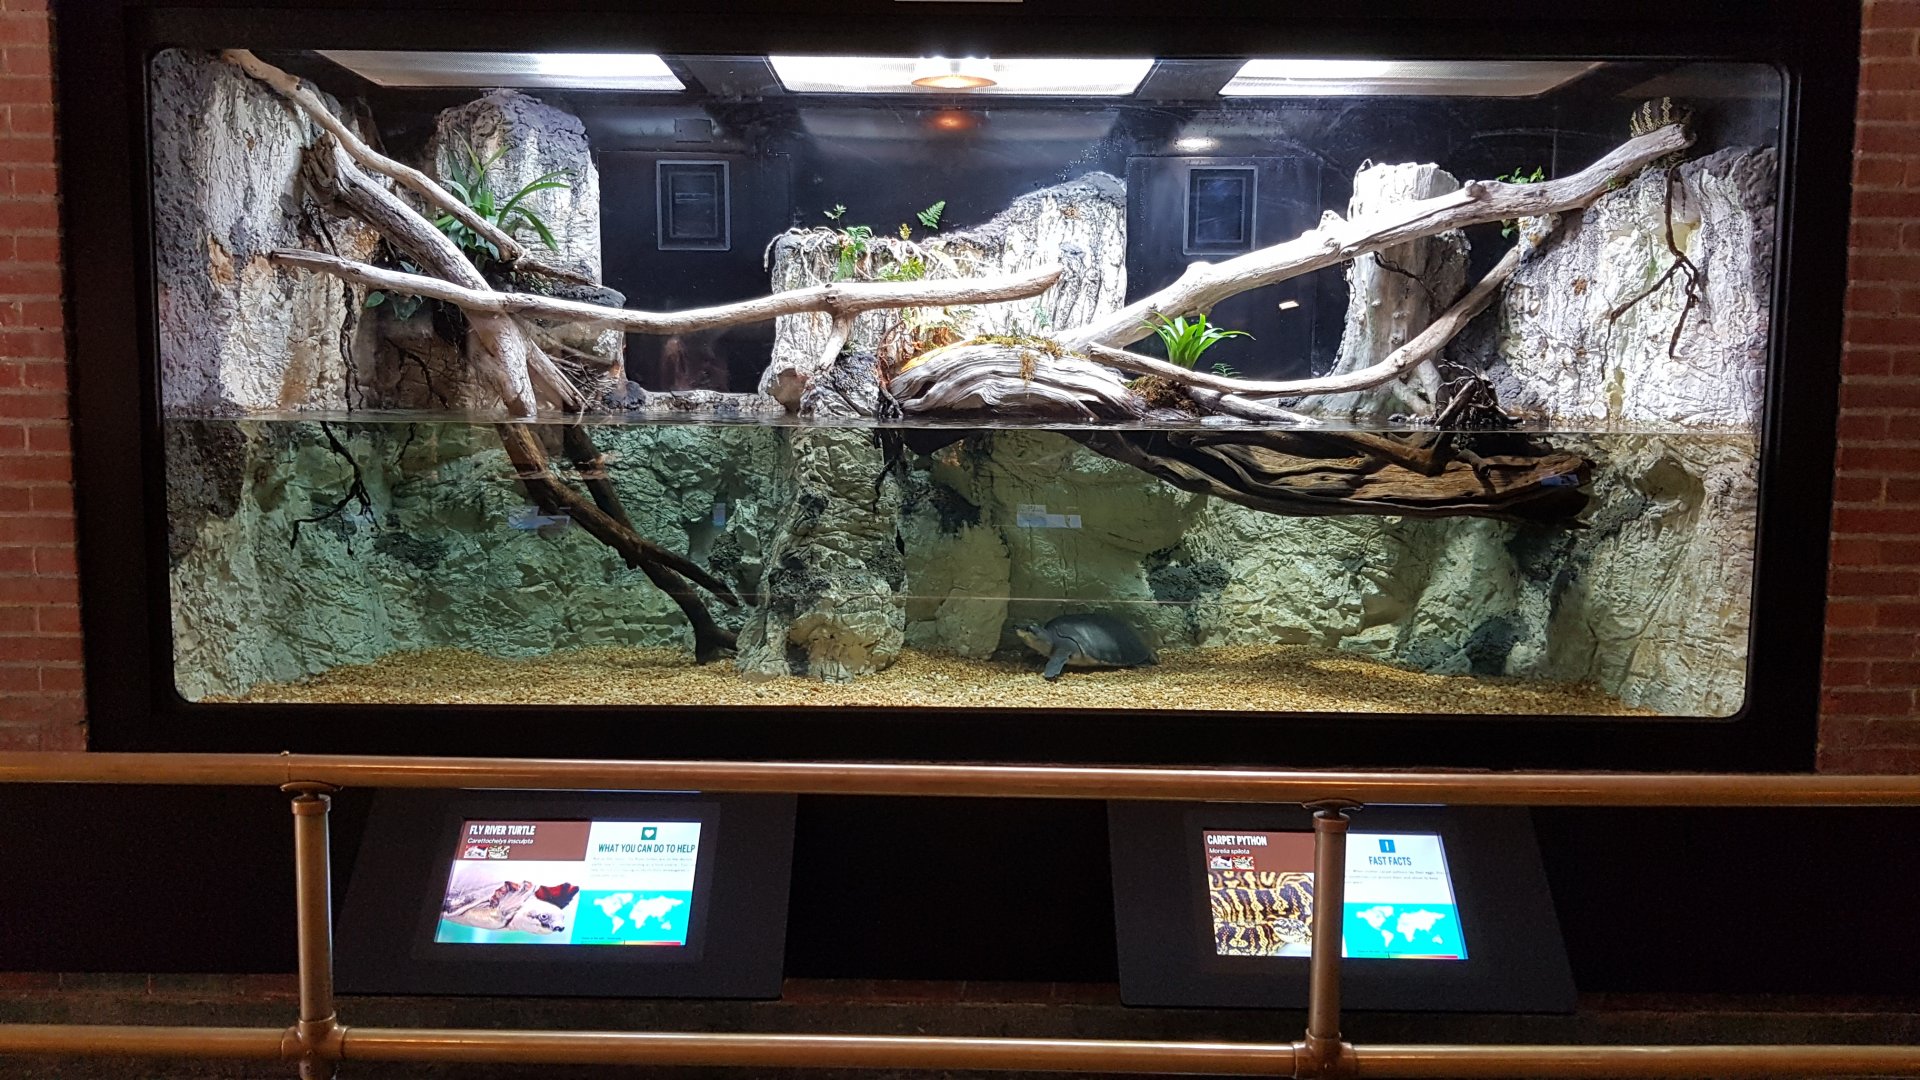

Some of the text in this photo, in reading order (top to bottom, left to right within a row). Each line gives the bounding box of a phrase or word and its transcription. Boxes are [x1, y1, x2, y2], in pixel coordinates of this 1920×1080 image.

[469, 825, 536, 835] FLY RIVER TURTLE
[1207, 835, 1268, 846] CARPET PYTHON
[598, 843, 696, 853] WHAT YOU CAN DO TO HELP
[1368, 856, 1412, 866] FAST FACTS
